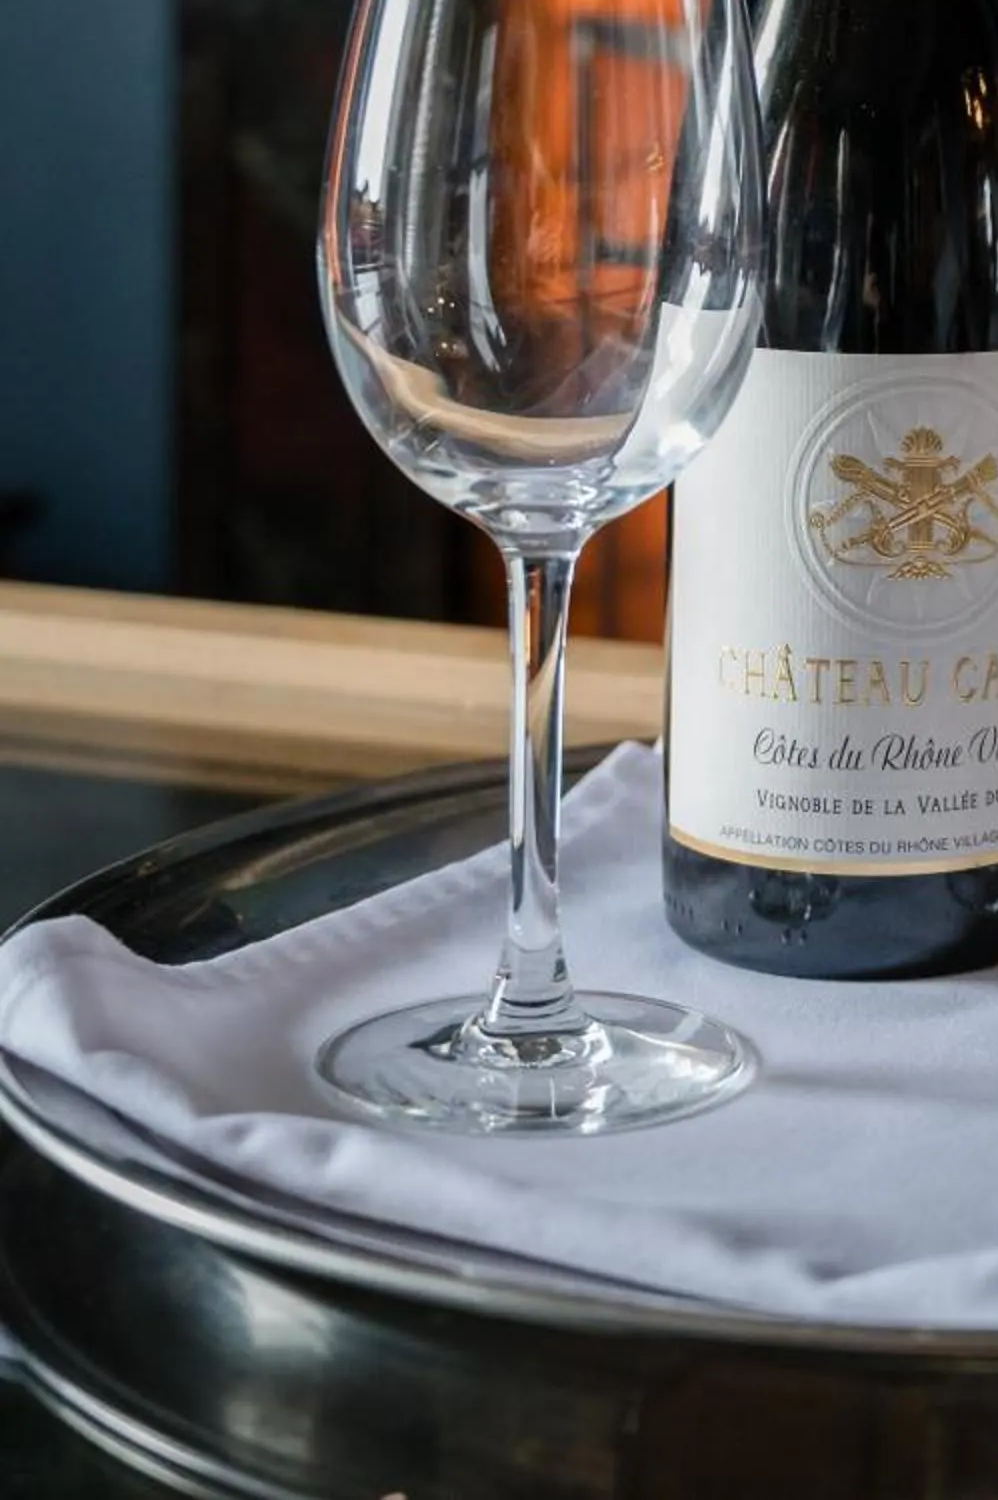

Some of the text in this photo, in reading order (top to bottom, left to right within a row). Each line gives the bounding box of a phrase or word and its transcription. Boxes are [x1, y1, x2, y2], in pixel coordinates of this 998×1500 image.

[718, 643, 929, 707] CHÂTEAU
[753, 726, 820, 770] Côtes
[828, 734, 866, 771] du
[871, 733, 964, 771] Rhône
[757, 788, 843, 815] VIGNOBLE
[851, 798, 873, 815] DE
[883, 798, 906, 816] LA
[917, 789, 977, 815] VALLÉE
[719, 825, 809, 851] APPELLATION
[812, 836, 865, 853] CÔTES
[869, 840, 892, 855] DU
[896, 835, 949, 853] RHÔNE
